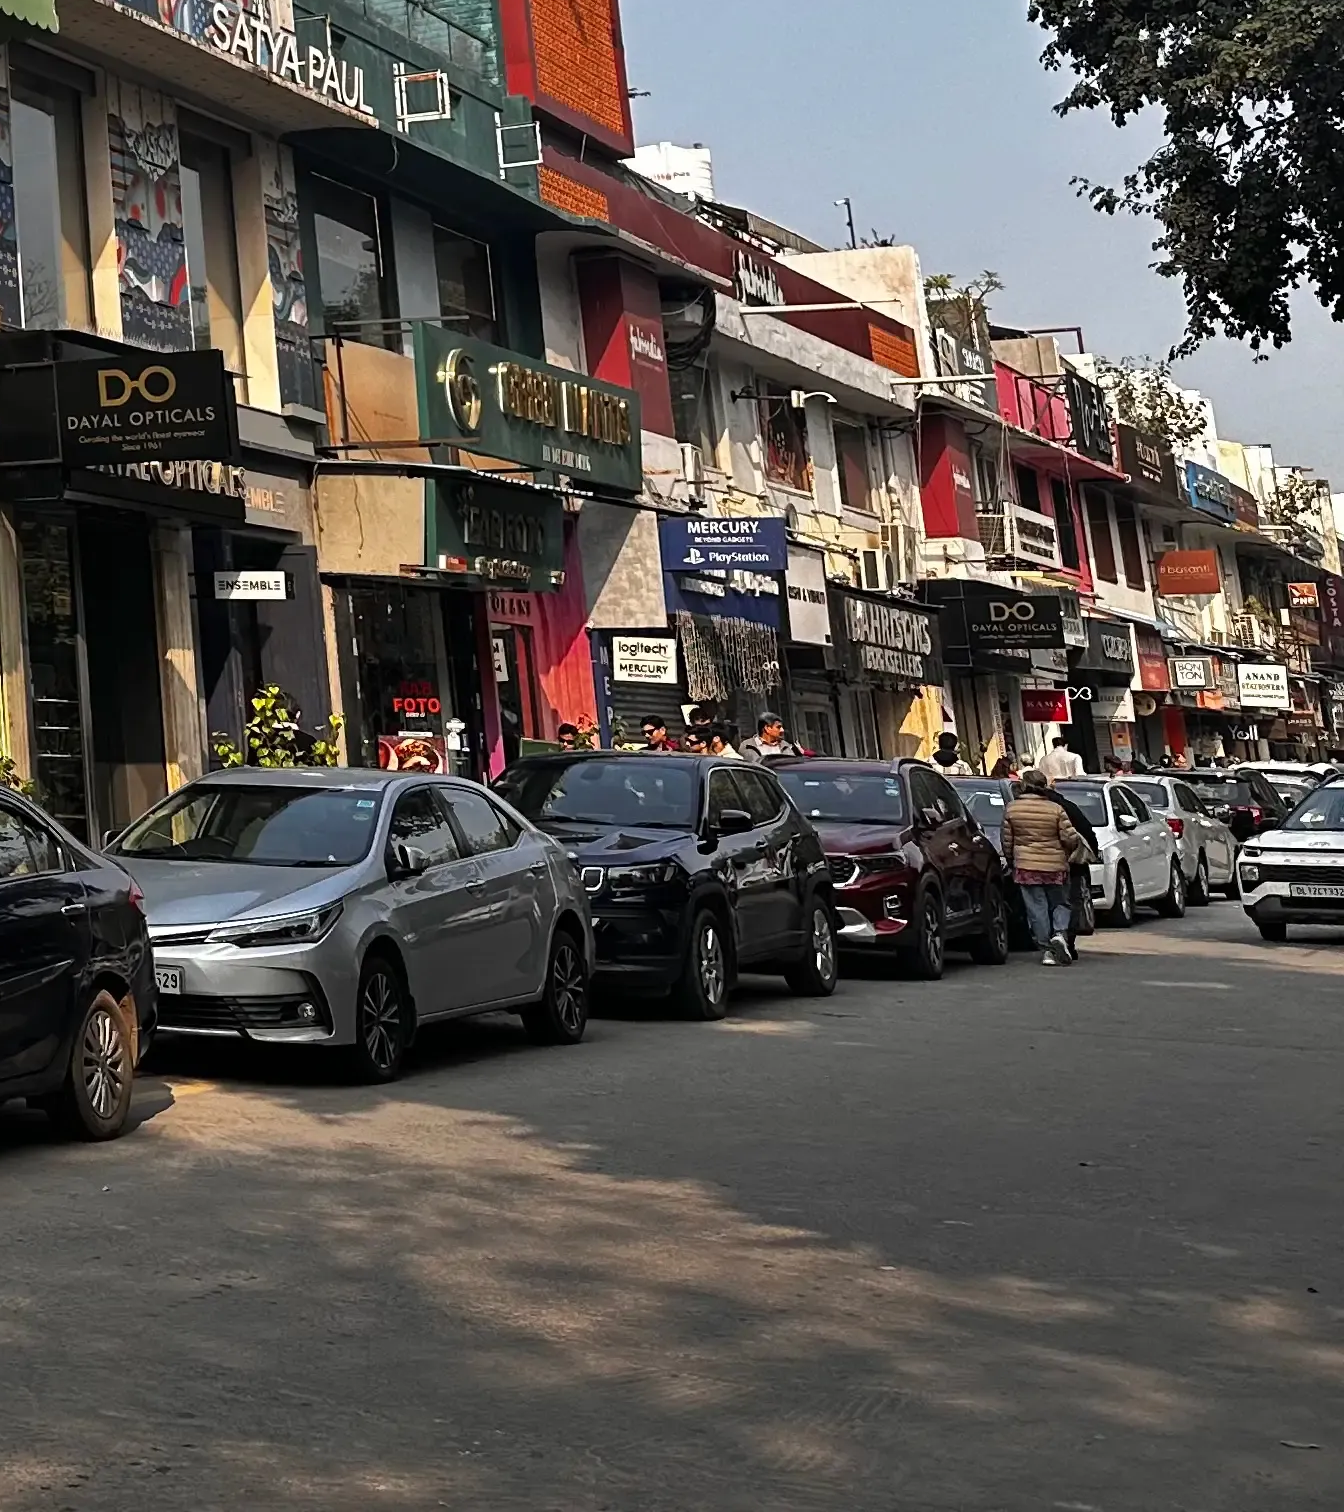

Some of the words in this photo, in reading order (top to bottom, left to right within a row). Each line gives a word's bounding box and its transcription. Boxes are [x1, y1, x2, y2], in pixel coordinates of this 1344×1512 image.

[212, 1, 306, 86] SATYA
[308, 44, 375, 116] PAUL
[66, 414, 123, 430] DAYAL
[128, 405, 216, 427] OPTICALS
[686, 520, 760, 534] MERCURY
[708, 551, 771, 565] PlayStation
[217, 579, 281, 592] ENSEMBLE
[971, 623, 1005, 633] DAYAL
[1007, 622, 1058, 633] OPTICALS
[617, 640, 669, 657] logitech
[619, 663, 669, 675] MERCURY
[1179, 671, 1204, 680] TON
[1244, 672, 1281, 681] ANAND
[392, 697, 442, 713] FOTO
